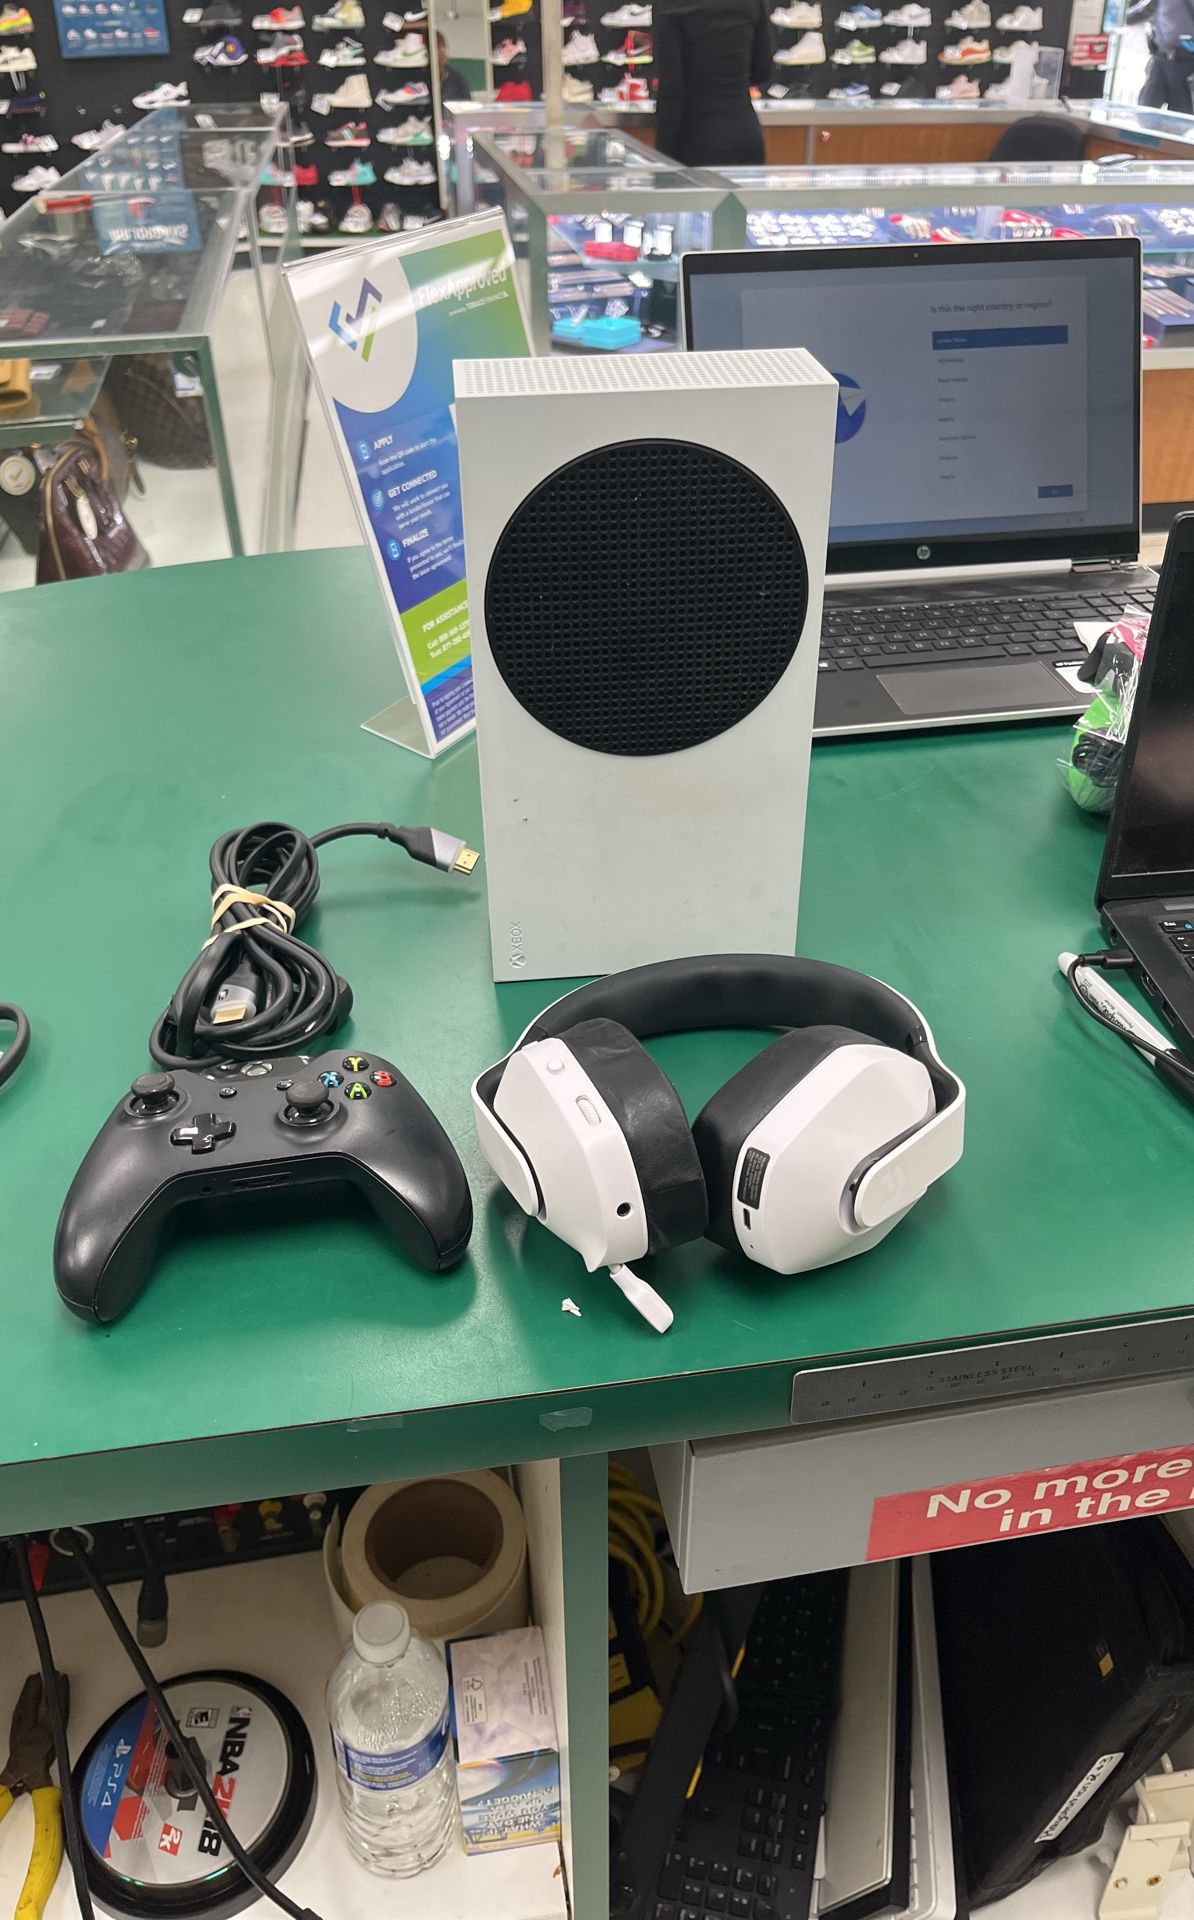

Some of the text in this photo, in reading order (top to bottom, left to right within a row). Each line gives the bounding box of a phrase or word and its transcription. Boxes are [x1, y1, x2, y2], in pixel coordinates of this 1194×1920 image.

[416, 262, 507, 307] FlexApproved
[986, 302, 1014, 312] country
[374, 434, 394, 451] APPLY
[388, 469, 438, 498] GET CONNECTED
[402, 528, 430, 548] FINALIZE
[422, 620, 436, 632] FOR
[510, 921, 522, 953] XBOX
[348, 1056, 364, 1072] Y
[320, 1072, 339, 1088] X
[374, 1070, 392, 1087] B
[349, 1082, 368, 1099] A
[938, 1368, 998, 1384] STAINLESS
[1000, 1363, 1034, 1375] STEEL
[926, 1458, 1191, 1519] No more
[999, 1508, 1053, 1533] in
[1075, 1487, 1171, 1519] the
[217, 1716, 251, 1776] NBA
[101, 1762, 123, 1807] PS4
[487, 1813, 543, 1829] ONE DAY
[159, 1826, 182, 1851] 2K
